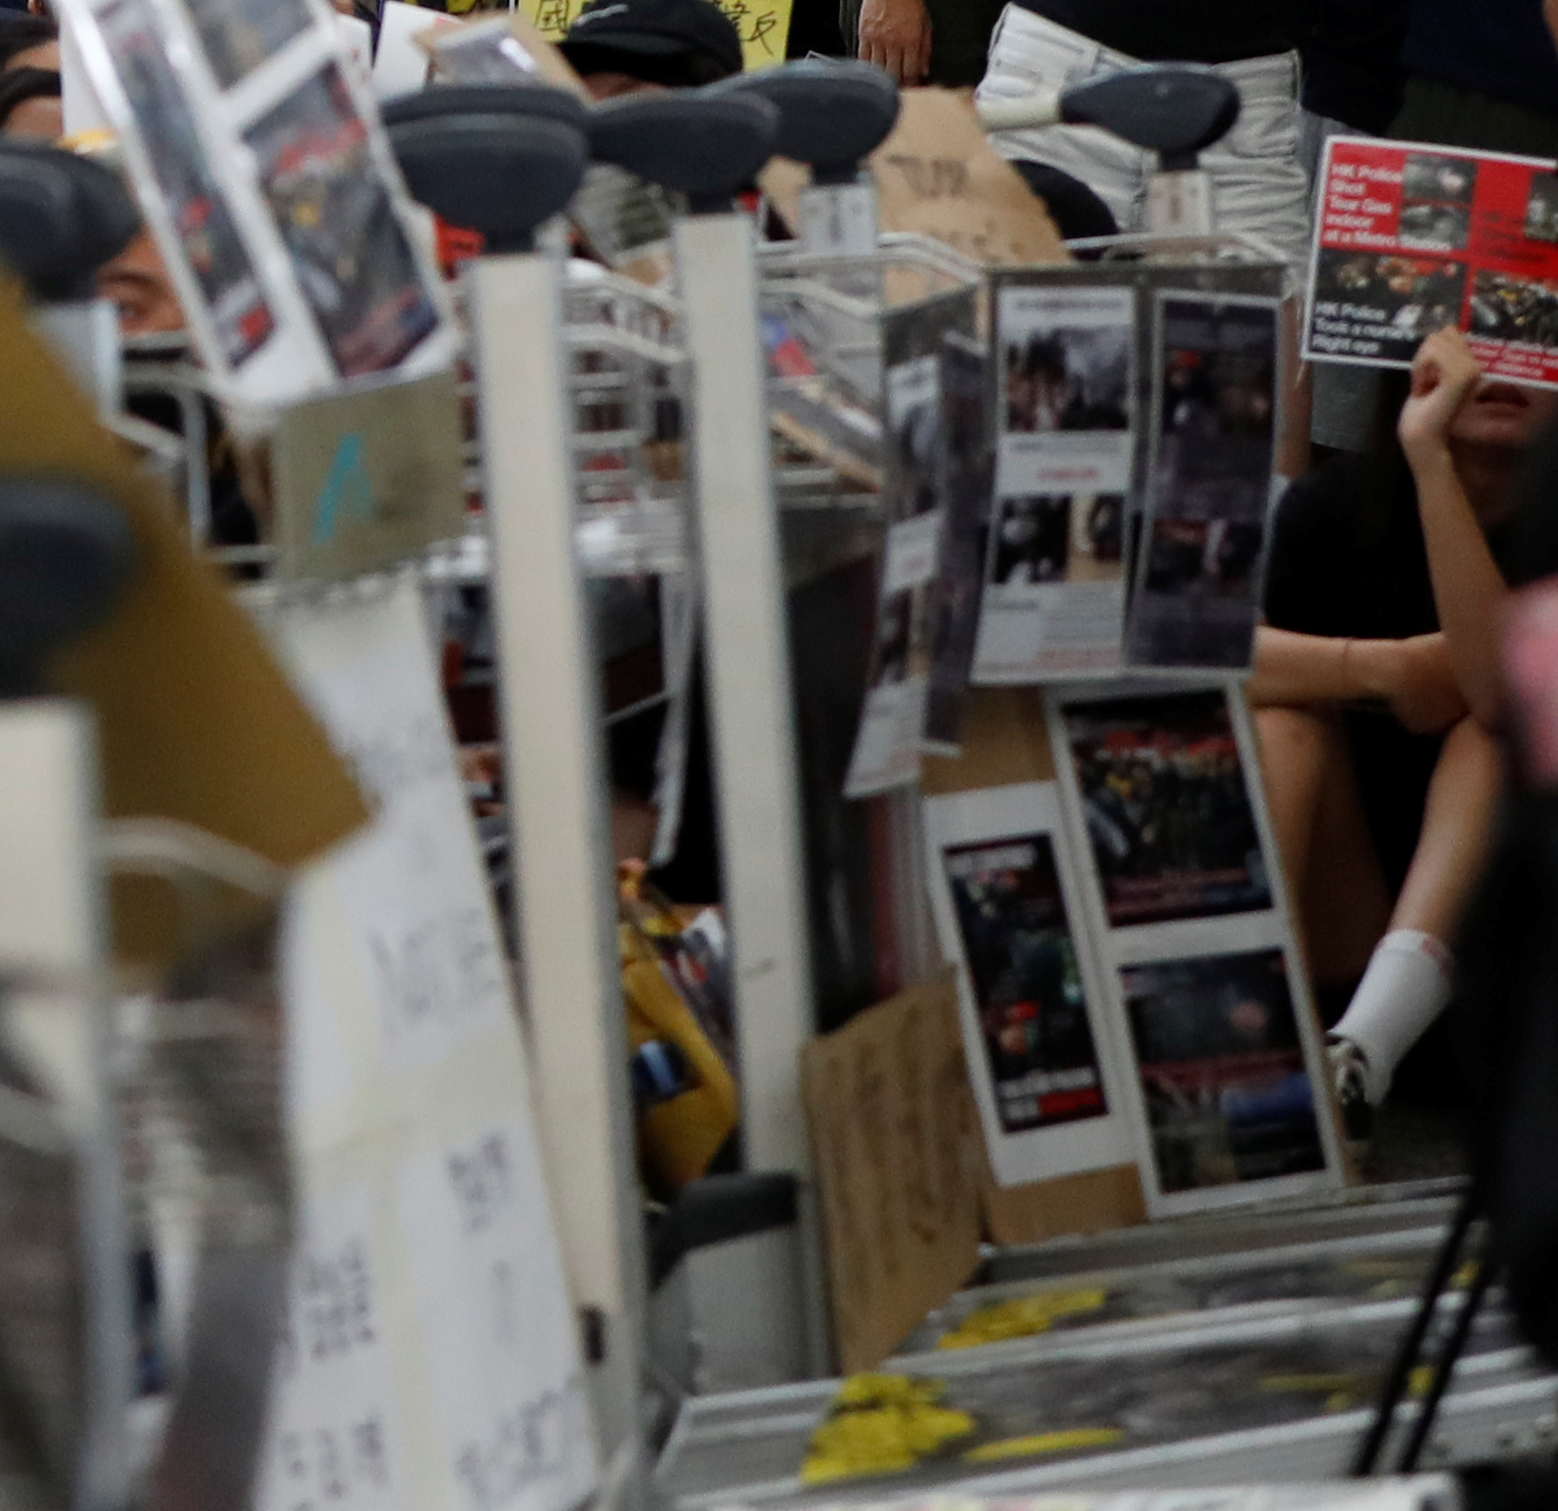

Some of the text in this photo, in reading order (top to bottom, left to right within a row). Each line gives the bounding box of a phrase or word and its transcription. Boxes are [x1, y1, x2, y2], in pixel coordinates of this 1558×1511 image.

[1333, 164, 1403, 183] HK Police
[1331, 179, 1366, 195] Shot
[1314, 302, 1386, 321] HK Police
